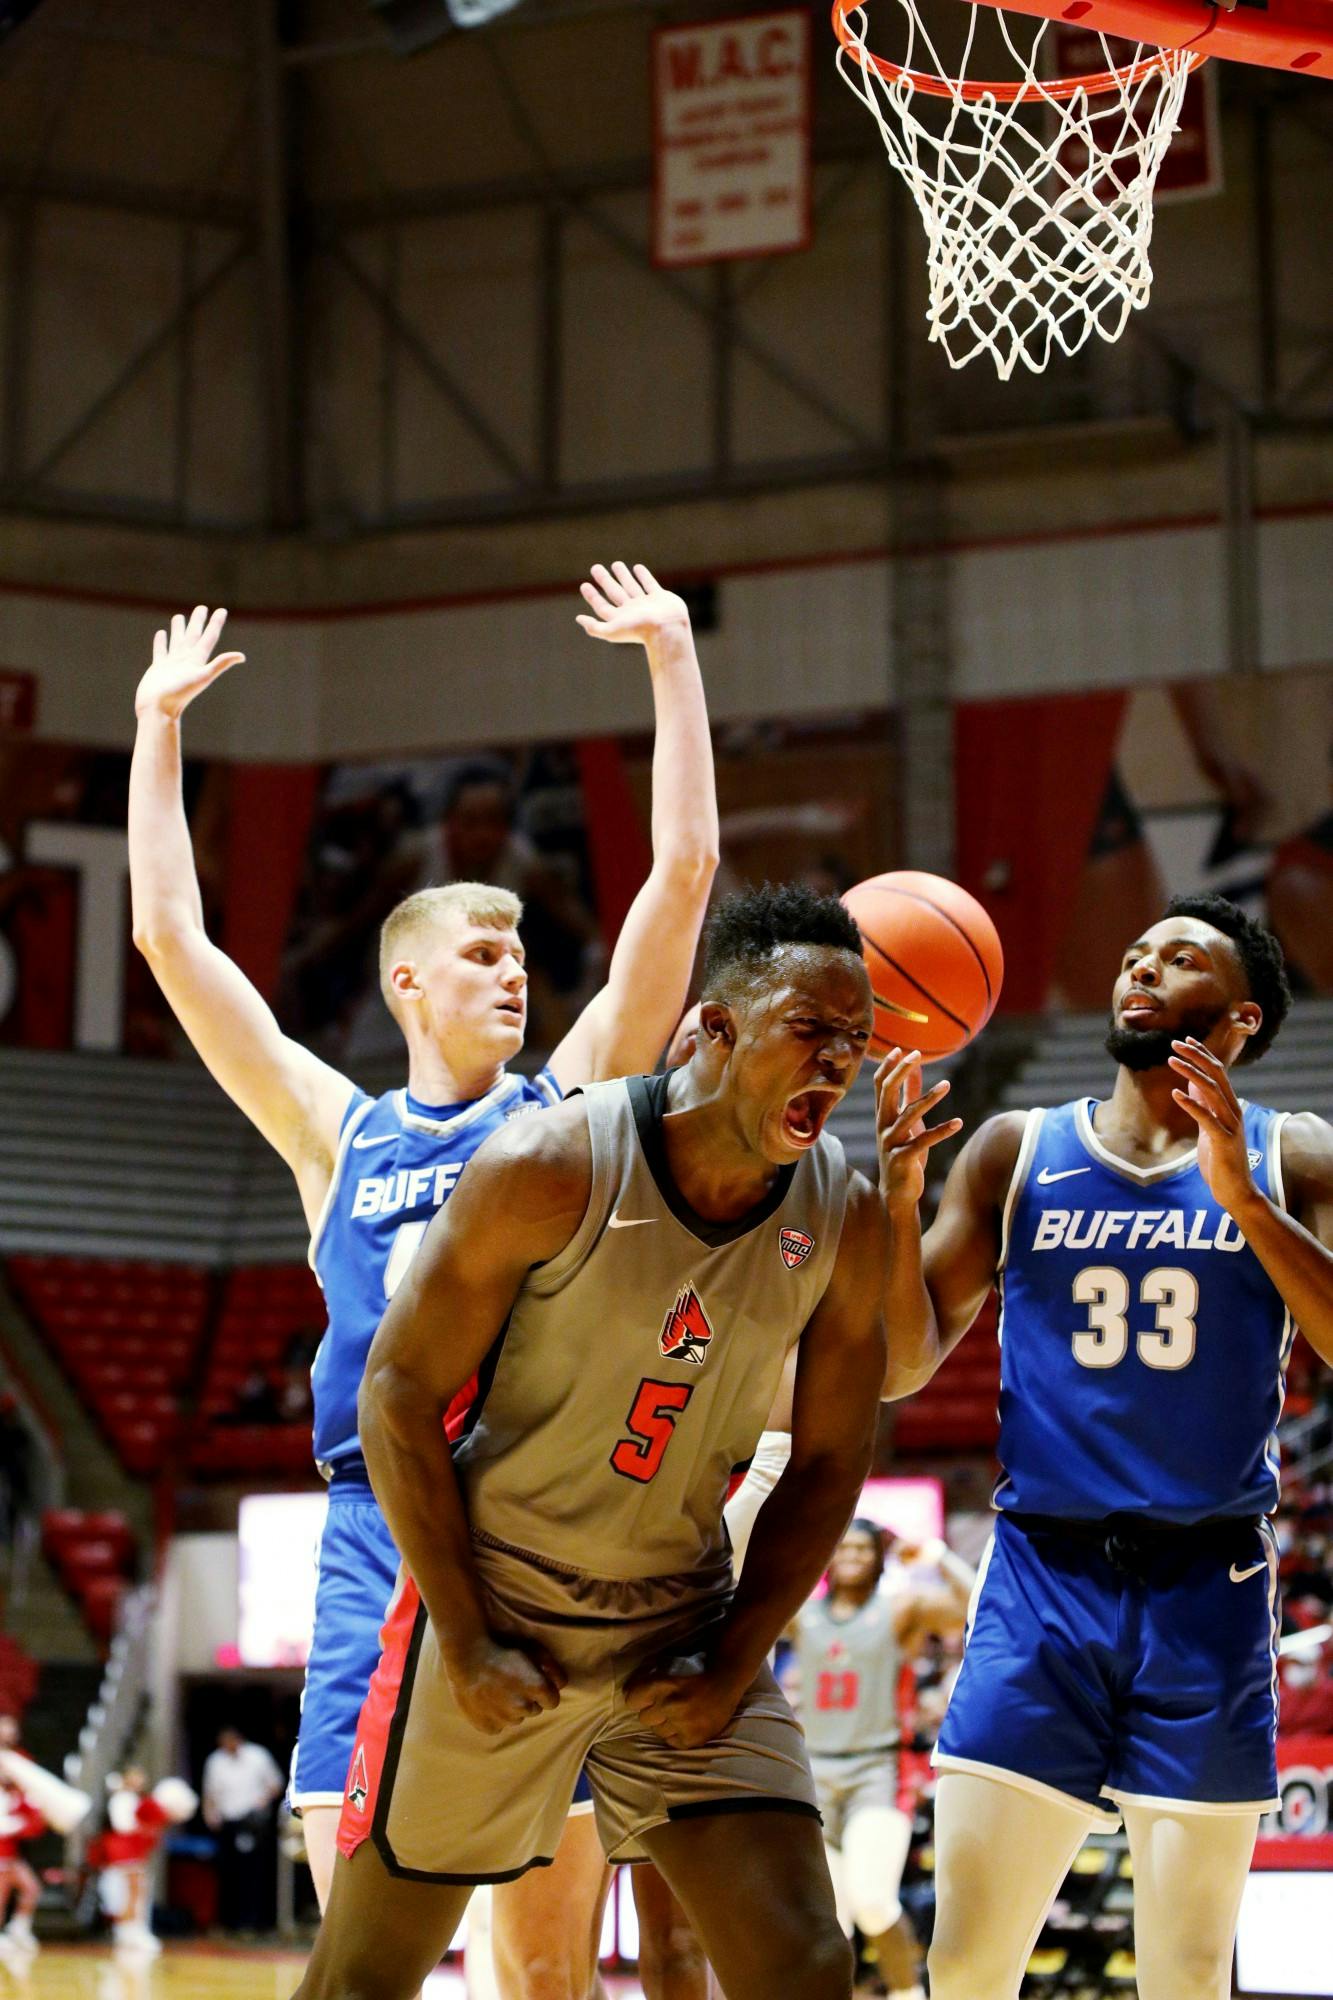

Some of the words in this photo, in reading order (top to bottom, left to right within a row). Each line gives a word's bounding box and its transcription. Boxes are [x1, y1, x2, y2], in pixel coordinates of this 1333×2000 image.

[350, 1161, 469, 1220] BUFF
[1031, 1209, 1246, 1252] BUFFALO
[1071, 1265, 1199, 1371] 33
[609, 1377, 694, 1484] 5
